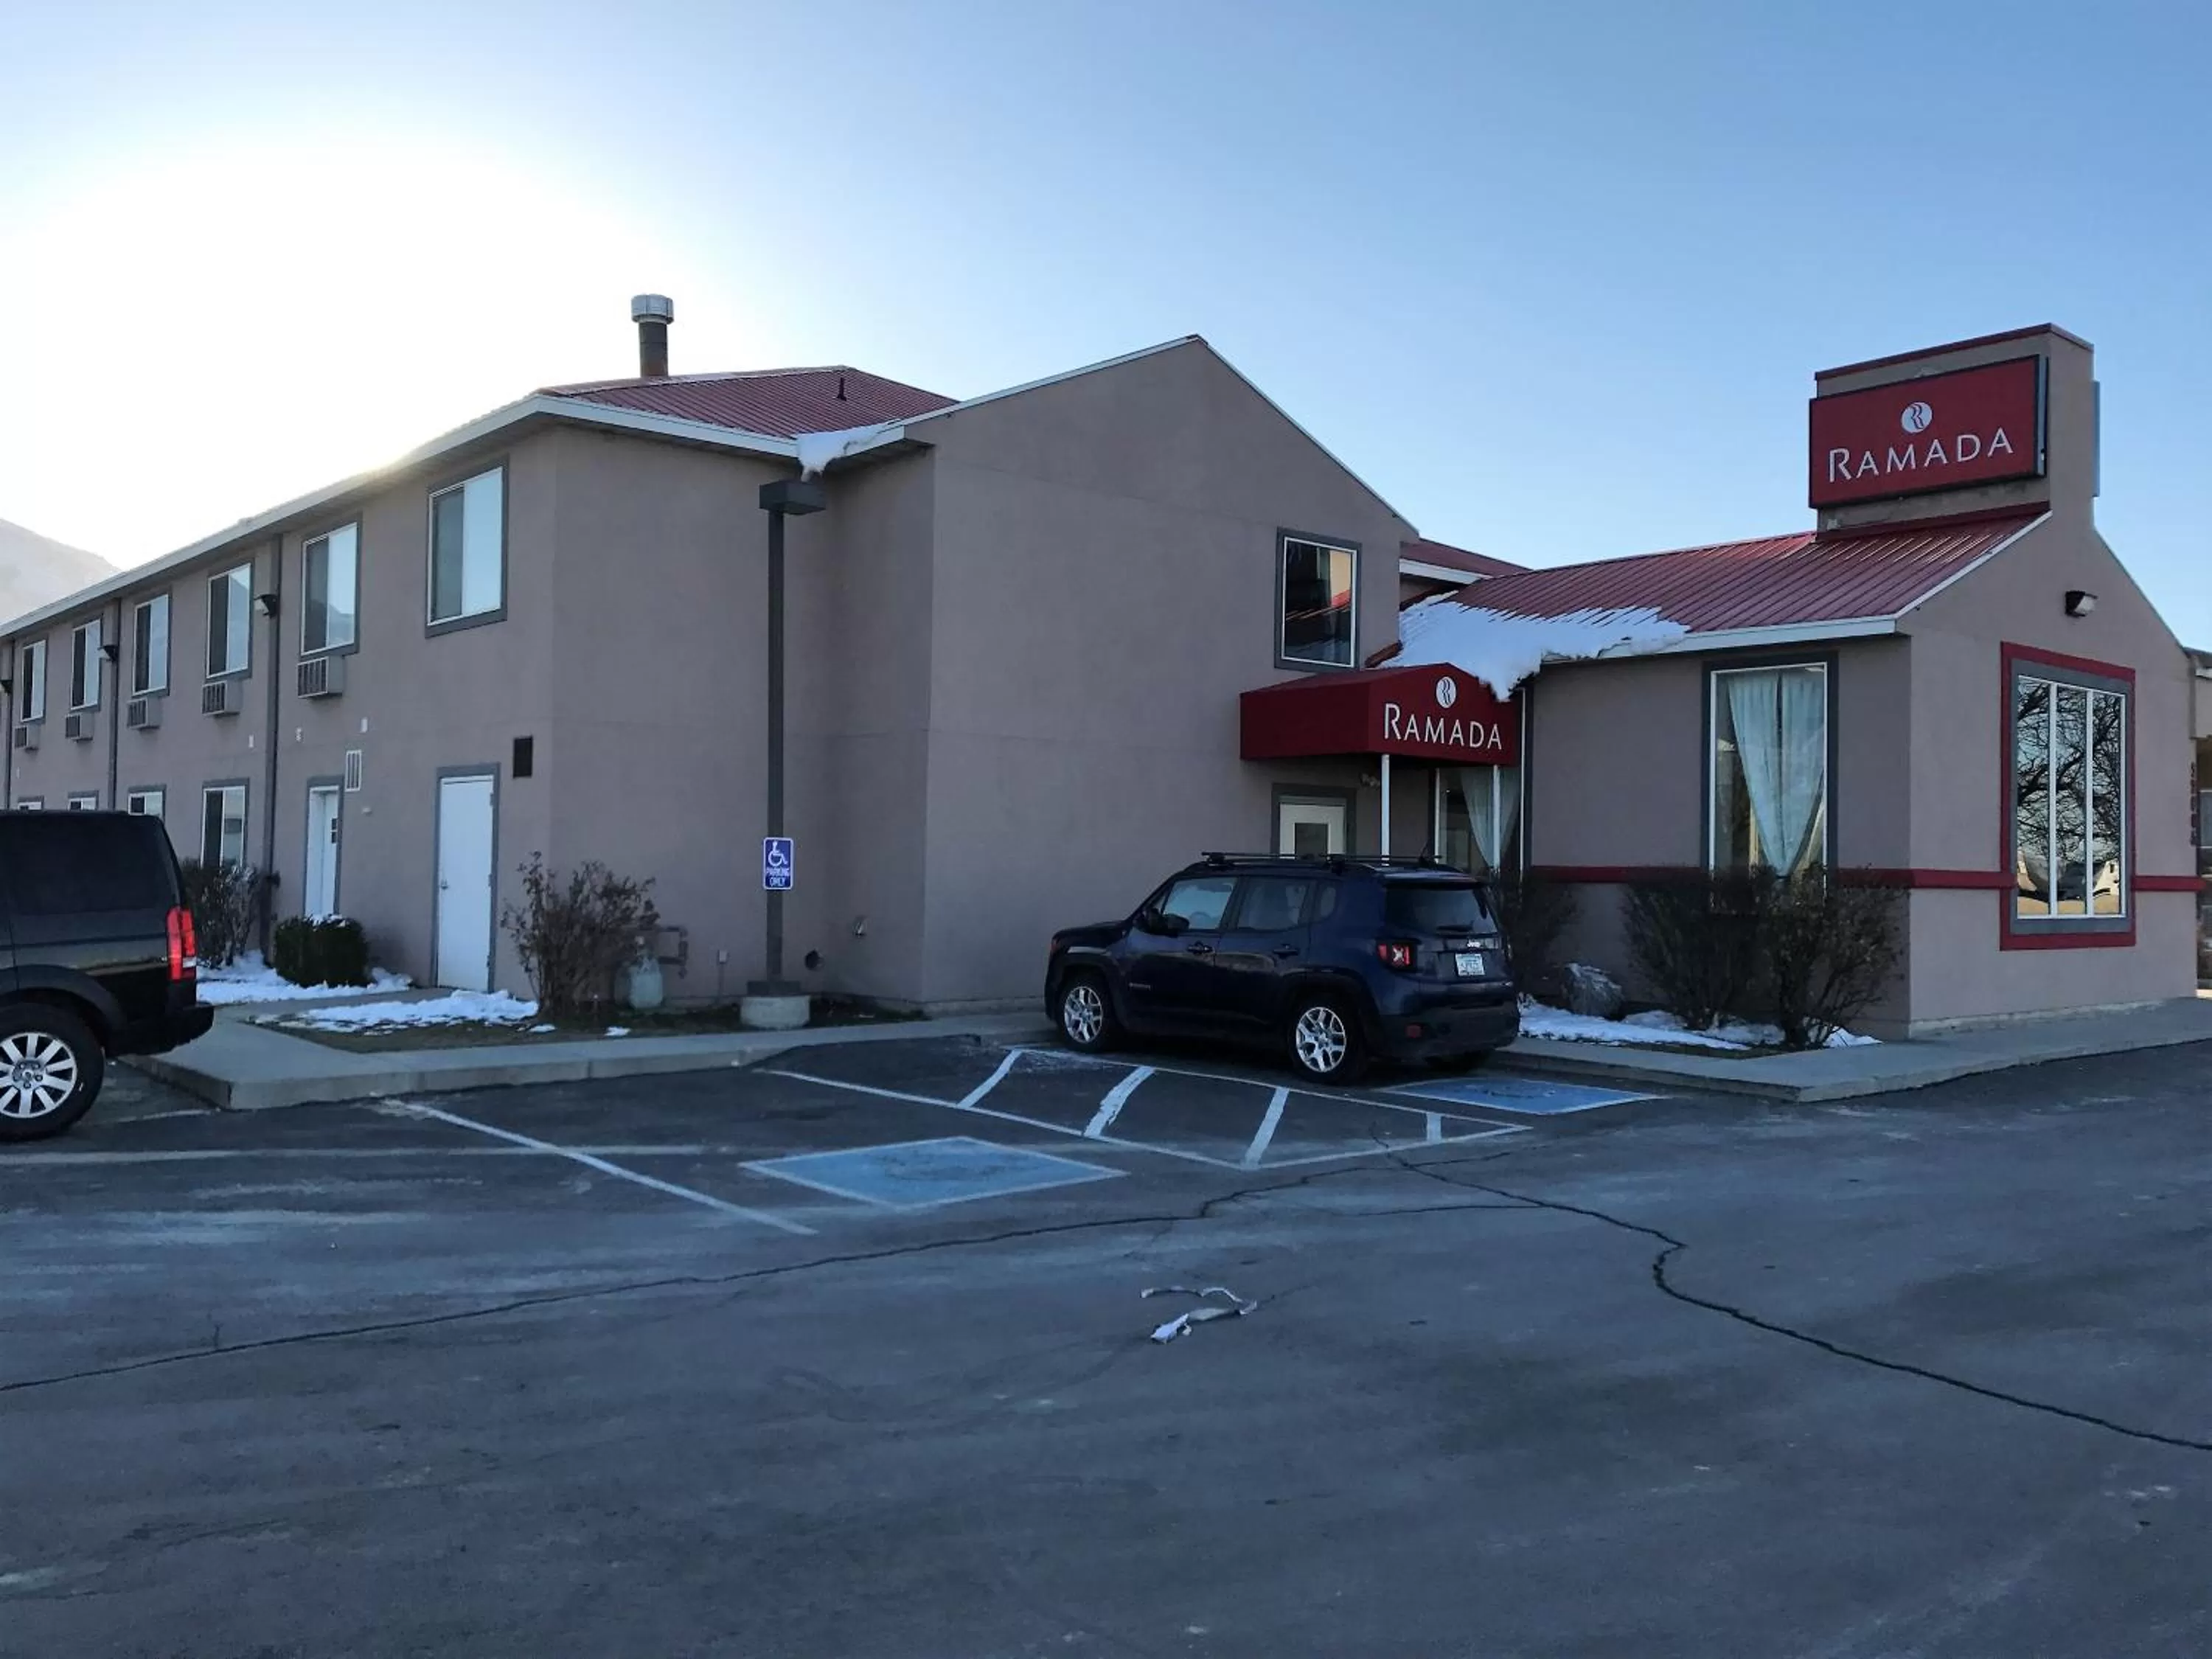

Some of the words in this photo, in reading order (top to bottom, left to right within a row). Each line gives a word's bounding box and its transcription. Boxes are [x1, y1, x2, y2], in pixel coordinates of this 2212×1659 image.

[1829, 427, 2014, 483] RAMADA
[1385, 703, 1502, 750] RAMADA
[767, 867, 790, 877] PARKING
[770, 877, 785, 886] ONLY
